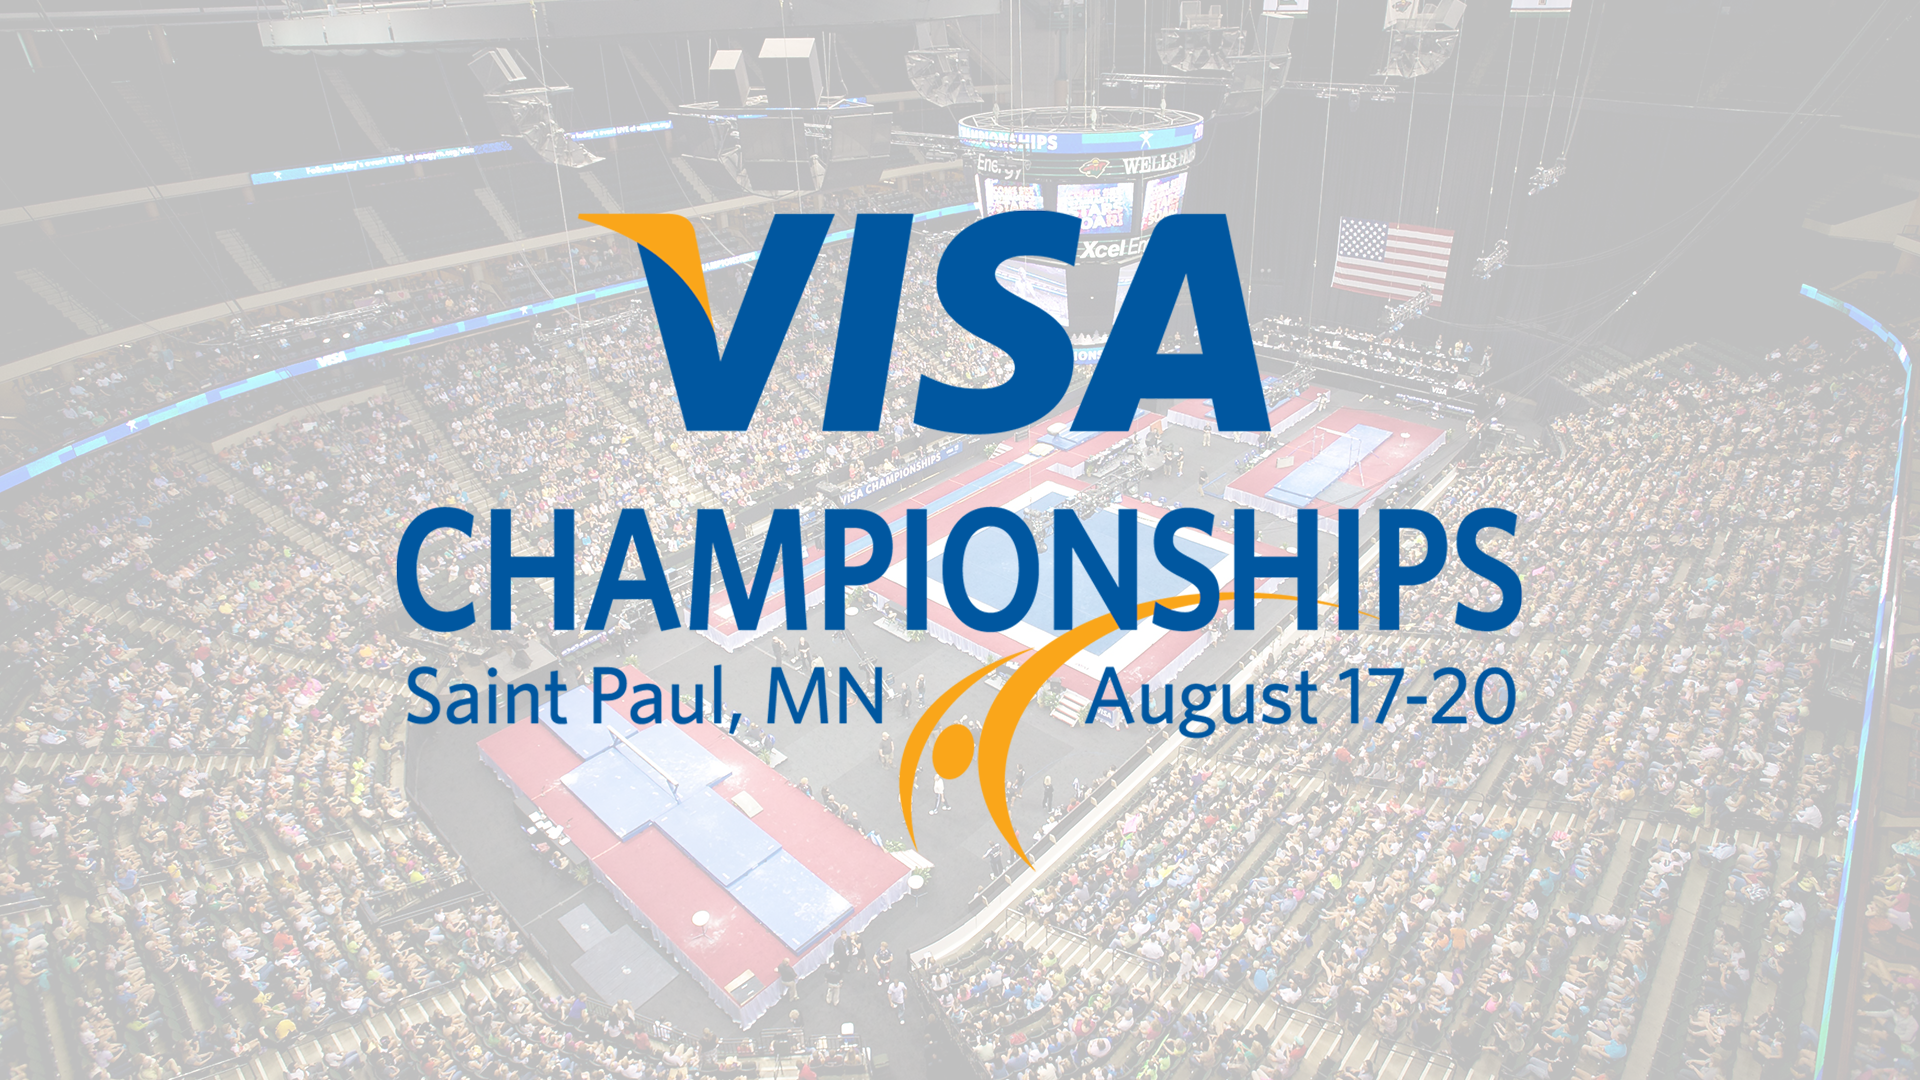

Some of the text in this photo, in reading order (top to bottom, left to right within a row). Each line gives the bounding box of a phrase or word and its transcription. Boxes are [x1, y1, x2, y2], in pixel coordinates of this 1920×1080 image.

[388, 154, 405, 164] LIVE
[1122, 151, 1177, 175] WELLS
[1080, 239, 1126, 259] Xcel
[1431, 385, 1447, 396] VISA
[839, 452, 942, 506] VISA CHAMPIONSHIPS
